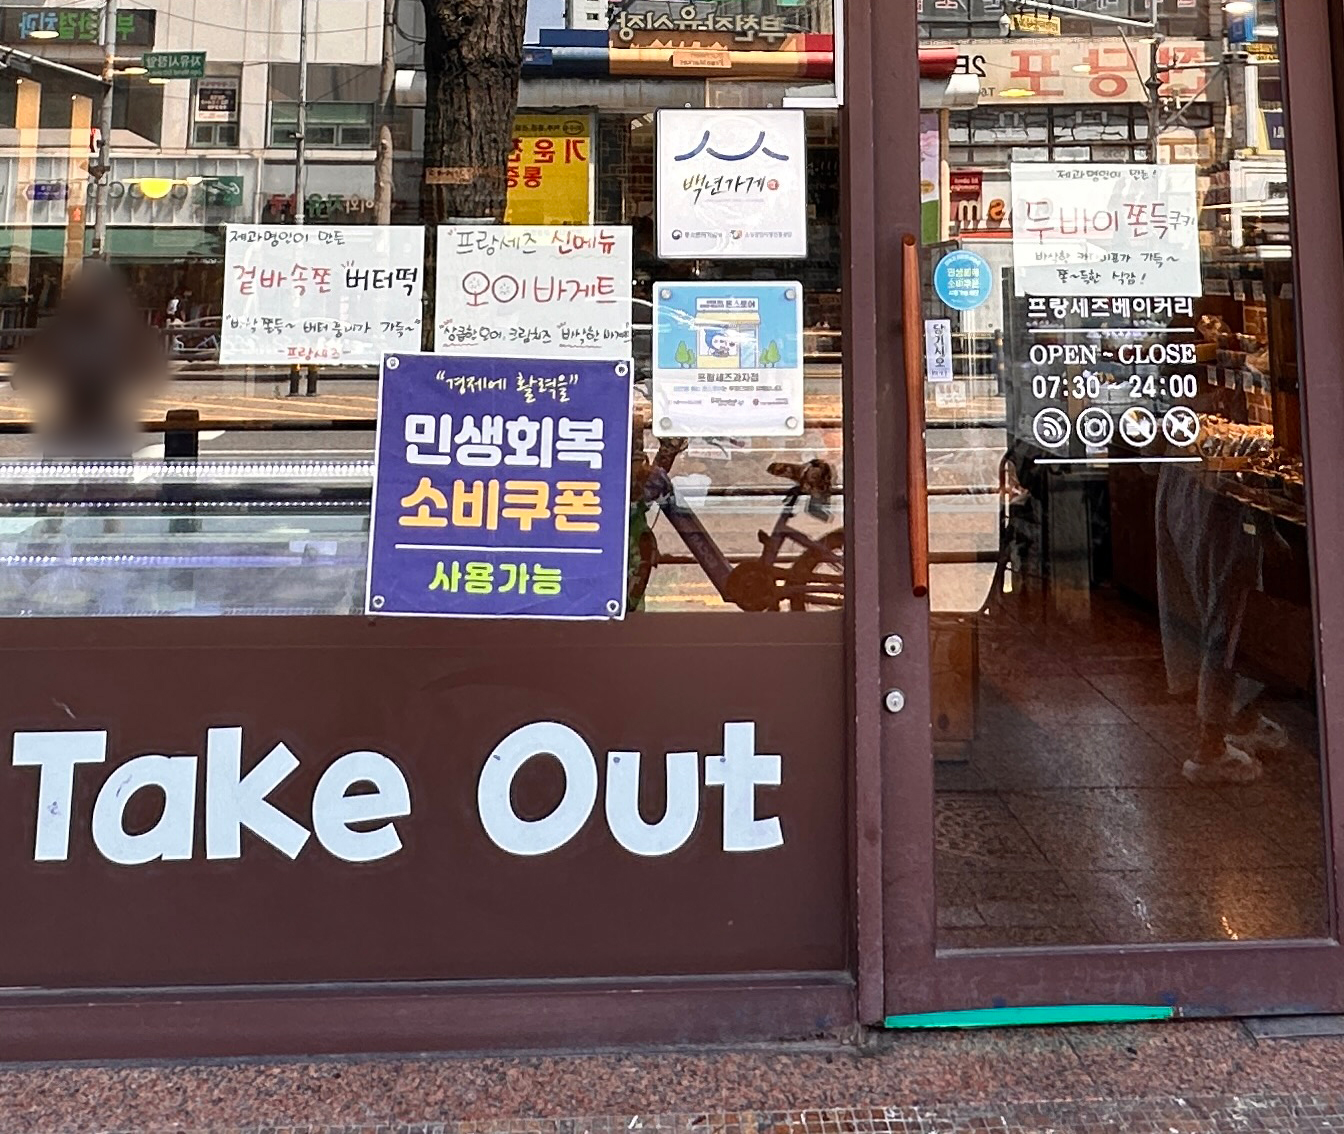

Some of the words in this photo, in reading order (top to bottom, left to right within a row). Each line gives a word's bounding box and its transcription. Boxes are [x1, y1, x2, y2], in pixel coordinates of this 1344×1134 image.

[683, 174, 766, 204] 백년가게
[1026, 201, 1119, 244] 두바이
[456, 231, 536, 255] 프랑세즈
[551, 229, 616, 254] 신메뉴
[346, 266, 418, 296] 버터떡
[462, 271, 617, 306] 오이바게트
[1028, 296, 1194, 319] 프랑세즈베이커리
[933, 324, 946, 367] 당기시오
[1030, 344, 1098, 365] OPEN
[1118, 343, 1197, 365] CLOSE
[1032, 374, 1100, 399] 07:30
[1128, 374, 1197, 399] 24:00
[405, 413, 605, 470] 민생회복
[398, 477, 603, 532] 소비쿠폰
[12, 726, 412, 863] Take
[477, 720, 784, 856] Out
